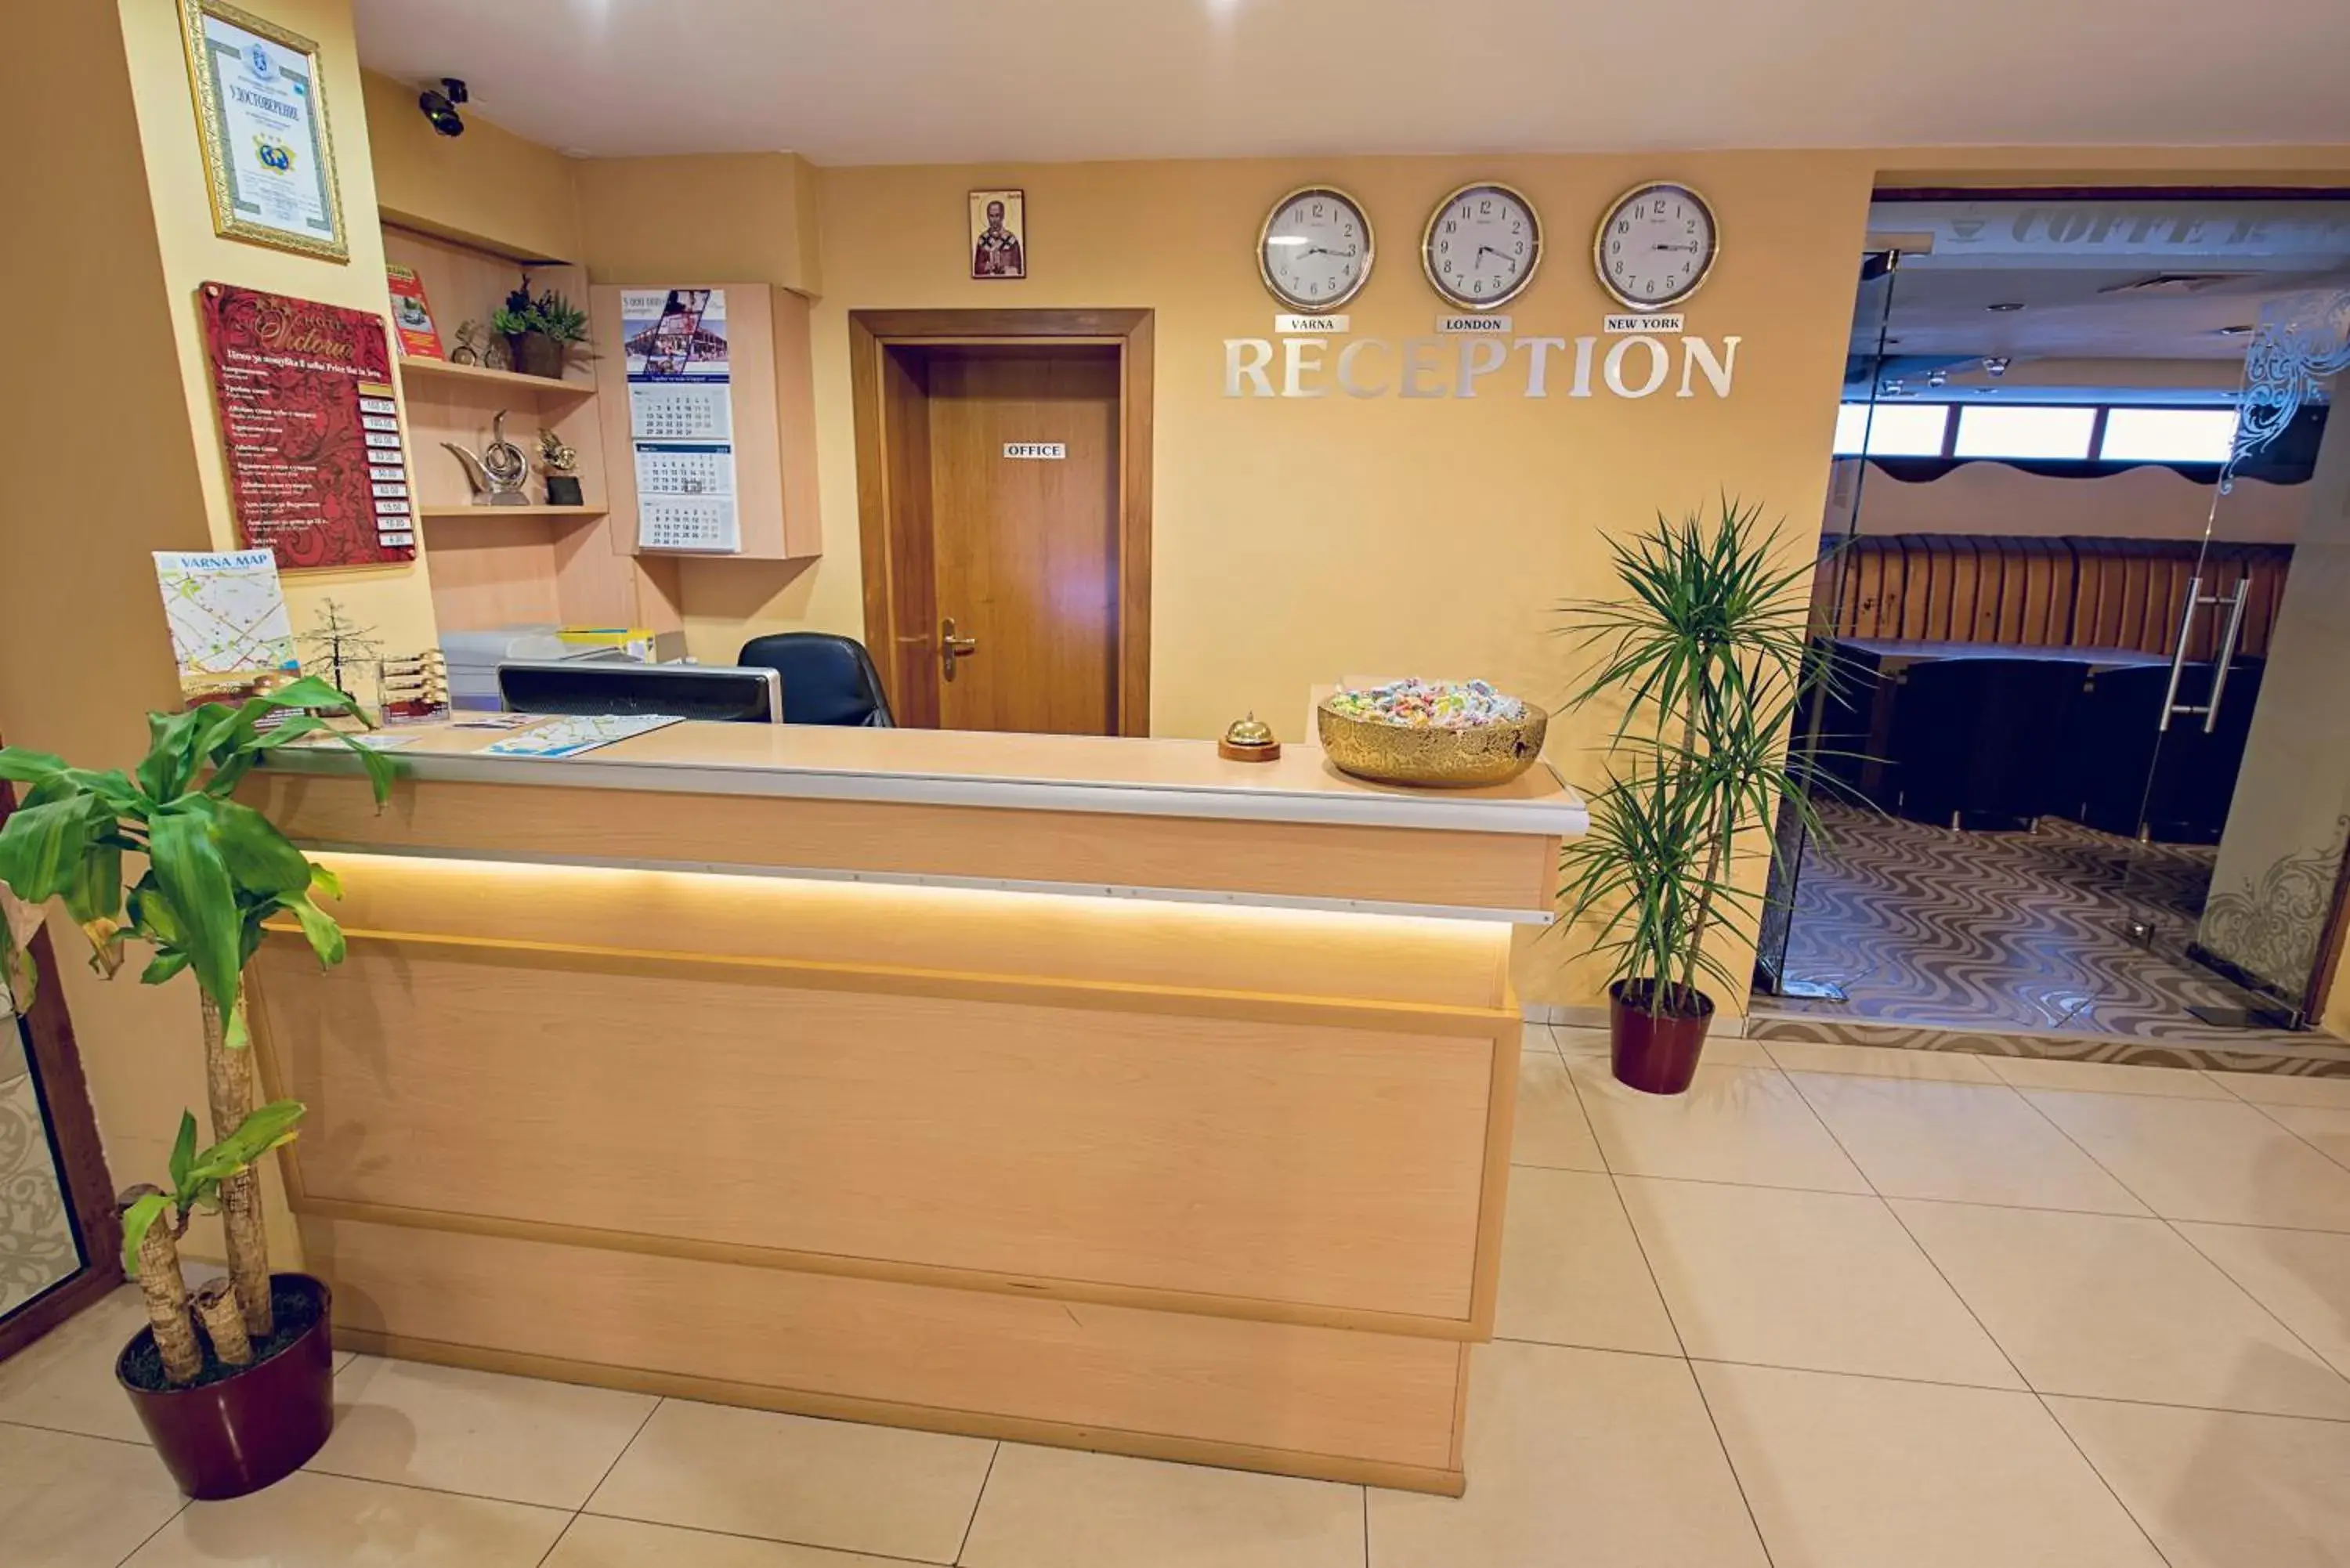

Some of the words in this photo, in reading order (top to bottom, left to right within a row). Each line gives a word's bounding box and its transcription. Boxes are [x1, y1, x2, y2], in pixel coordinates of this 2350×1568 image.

[1312, 202, 1323, 218] 12
[1462, 206, 1471, 219] 11
[1480, 201, 1491, 214] 12
[1502, 207, 1506, 220] 1
[1635, 205, 1644, 220] 11
[1654, 200, 1665, 214] 12
[1677, 205, 1681, 219] 1
[1295, 209, 1303, 223] 11
[1333, 209, 1337, 223] 1
[1344, 224, 1353, 237] 2
[1445, 221, 1456, 233] 10
[1512, 222, 1520, 234] 2
[1618, 221, 1629, 234] 10
[1687, 221, 1695, 234] 2
[1348, 244, 1356, 257] 3
[1441, 241, 1448, 254] 9
[1515, 241, 1524, 255] 3
[1613, 241, 1620, 255] 9
[1689, 240, 1698, 255] 3
[1342, 265, 1350, 276] 4
[1444, 261, 1452, 273] 8
[1508, 260, 1516, 273] 4
[1615, 262, 1624, 274] 8
[1682, 262, 1690, 273] 4
[1293, 277, 1300, 290] 7
[1311, 282, 1318, 294] 6
[1329, 277, 1336, 290] 5
[1456, 275, 1464, 288] 7
[1474, 280, 1481, 293] 6
[1493, 276, 1502, 288] 5
[1629, 276, 1636, 288] 7
[1647, 280, 1654, 293] 6
[1666, 276, 1674, 289] 5
[1292, 319, 1334, 330] VARNA
[1446, 319, 1502, 330] LONDON
[1607, 319, 1638, 330] NEW
[1640, 318, 1679, 329] YORK
[1222, 335, 1741, 399] RECEPTION
[1008, 446, 1061, 456] OFFICE
[181, 556, 232, 568] VARNA
[236, 554, 268, 565] MAP
